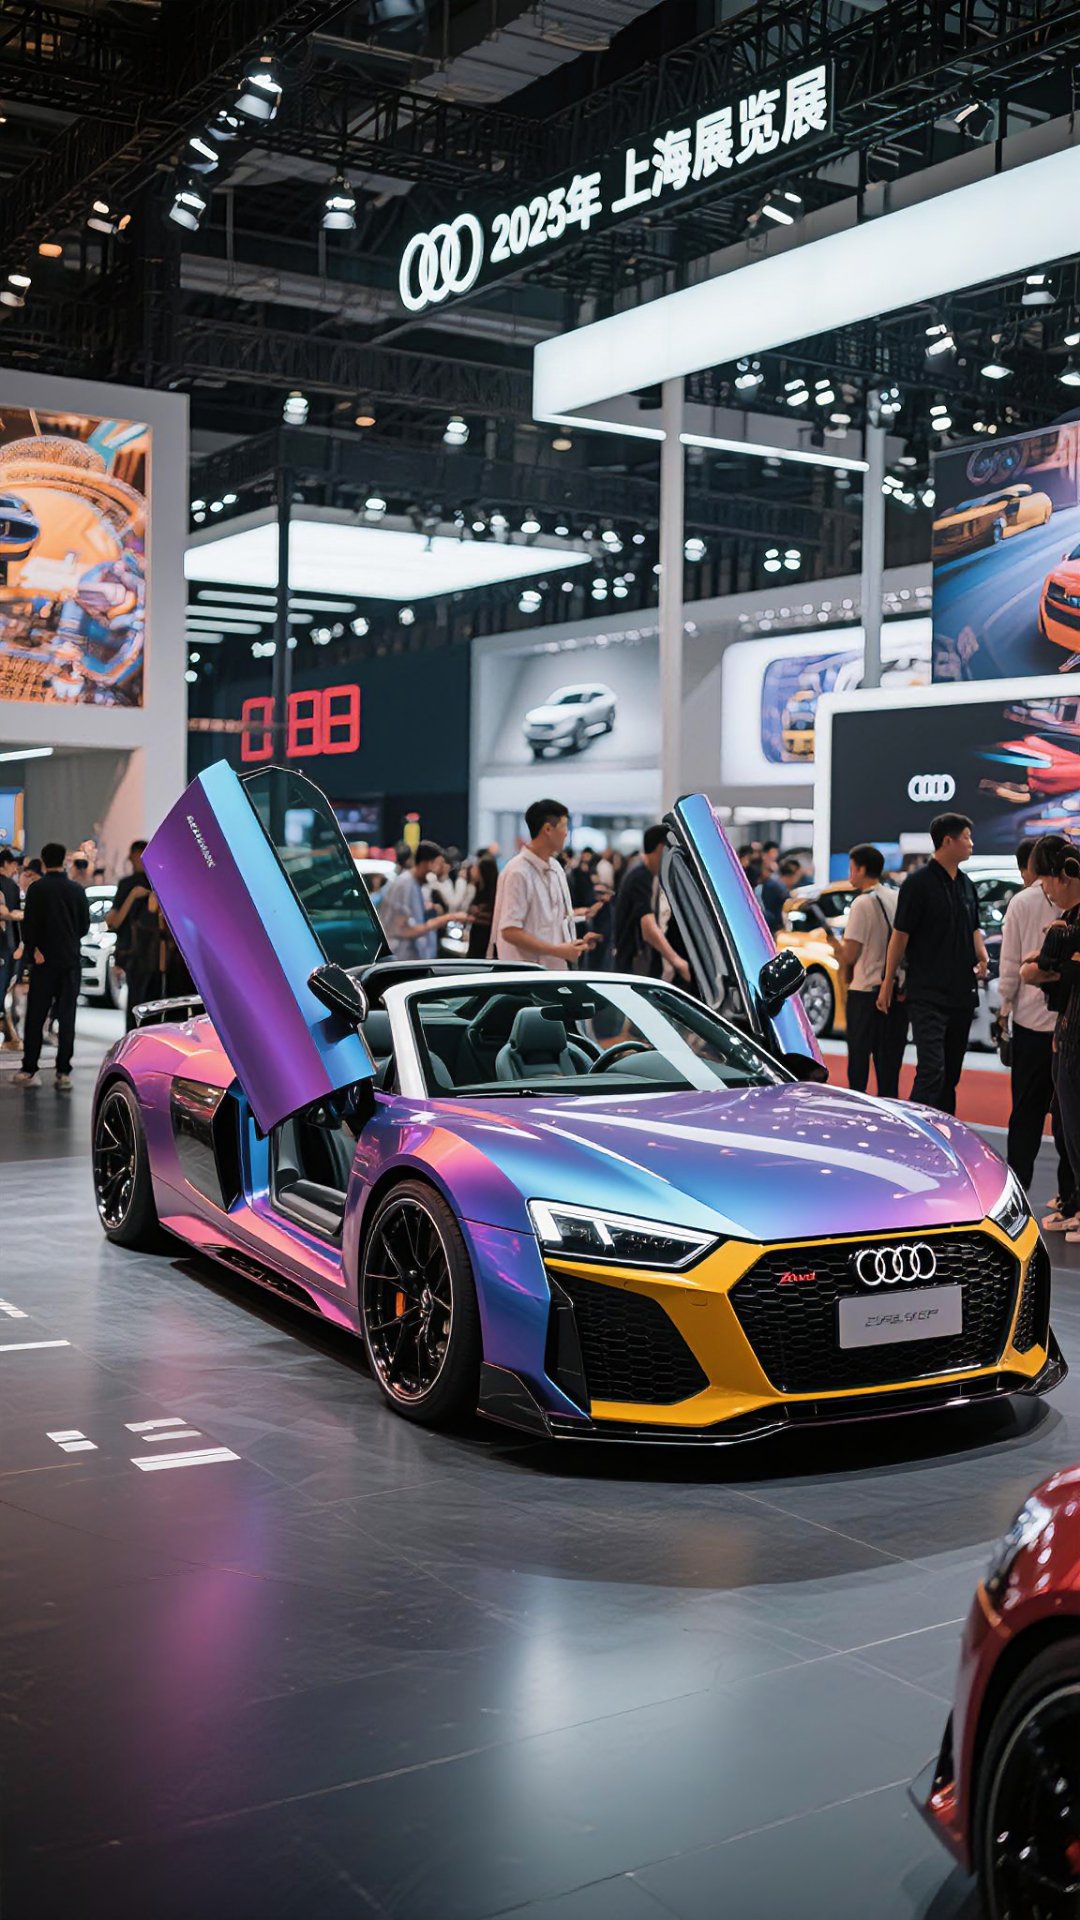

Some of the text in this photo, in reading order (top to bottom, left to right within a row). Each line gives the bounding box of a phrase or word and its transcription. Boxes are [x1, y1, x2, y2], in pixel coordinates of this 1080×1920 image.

[611, 65, 827, 213] 上海展览展
